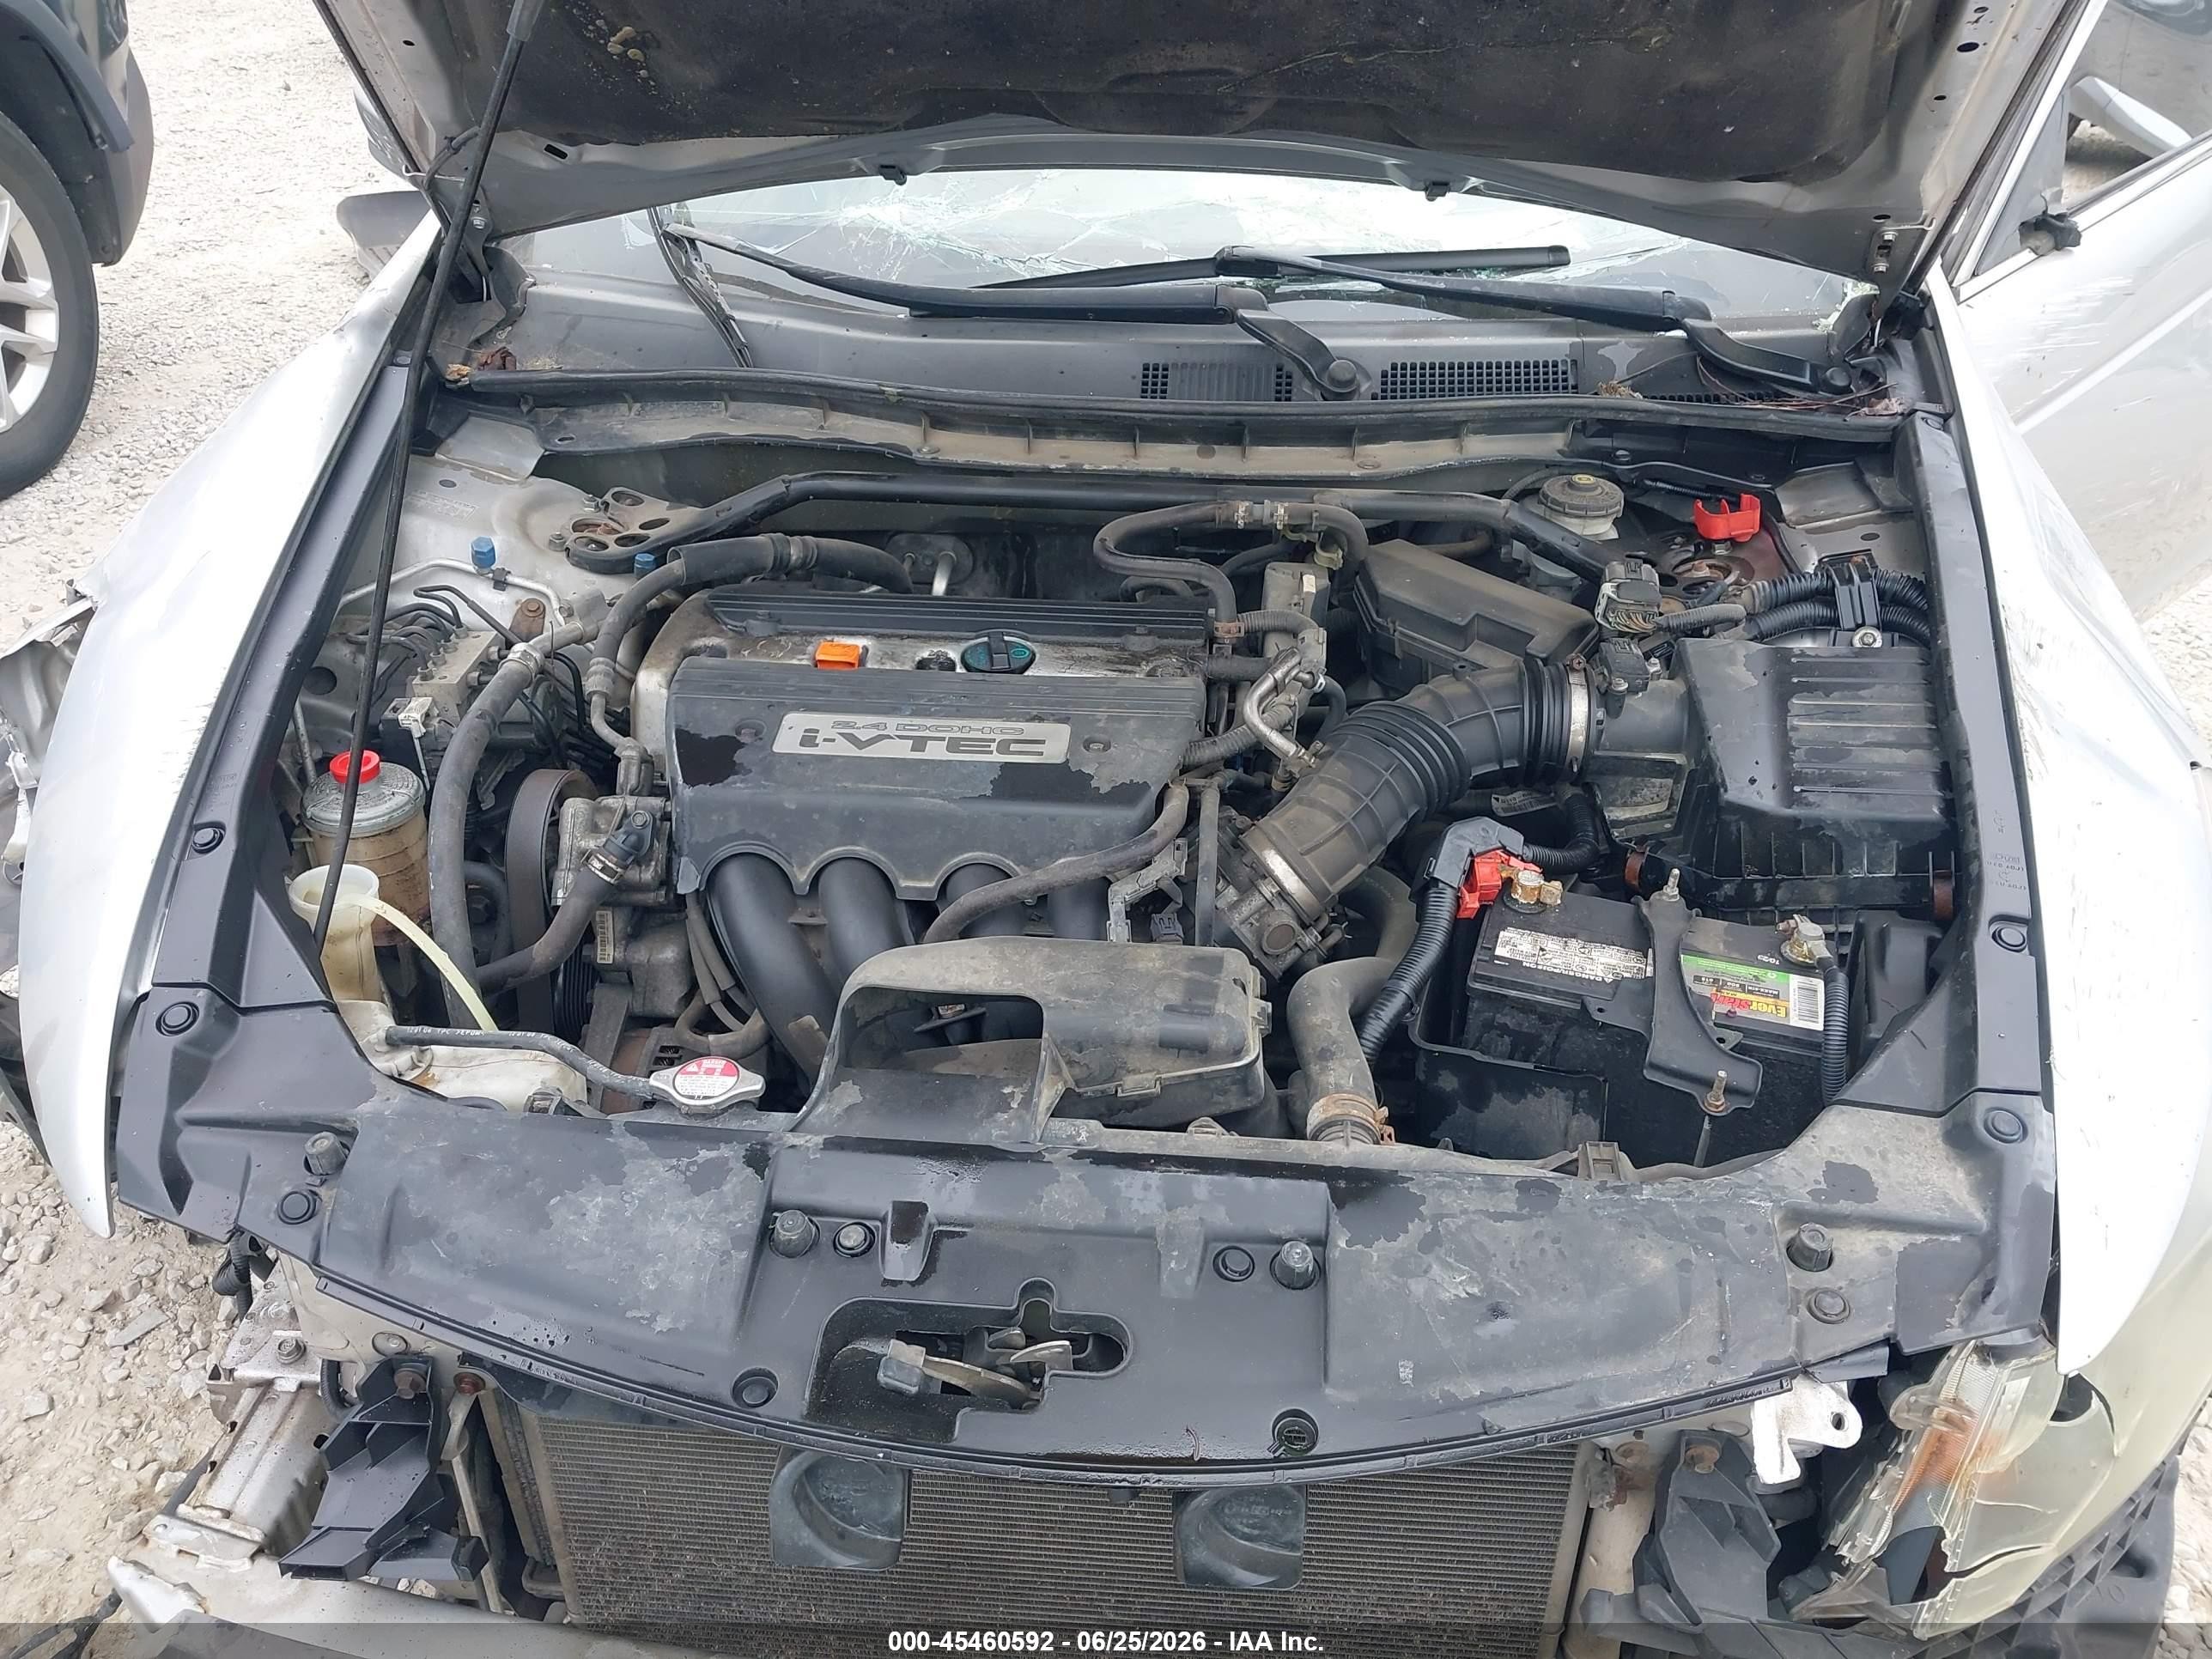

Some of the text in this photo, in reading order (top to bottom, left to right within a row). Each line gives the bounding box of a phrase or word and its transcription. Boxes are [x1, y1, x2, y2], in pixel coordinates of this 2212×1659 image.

[831, 720, 1024, 735] 2.4 DOHC
[799, 727, 1046, 757] i-VTEC
[1710, 993, 1787, 1018] EverStart
